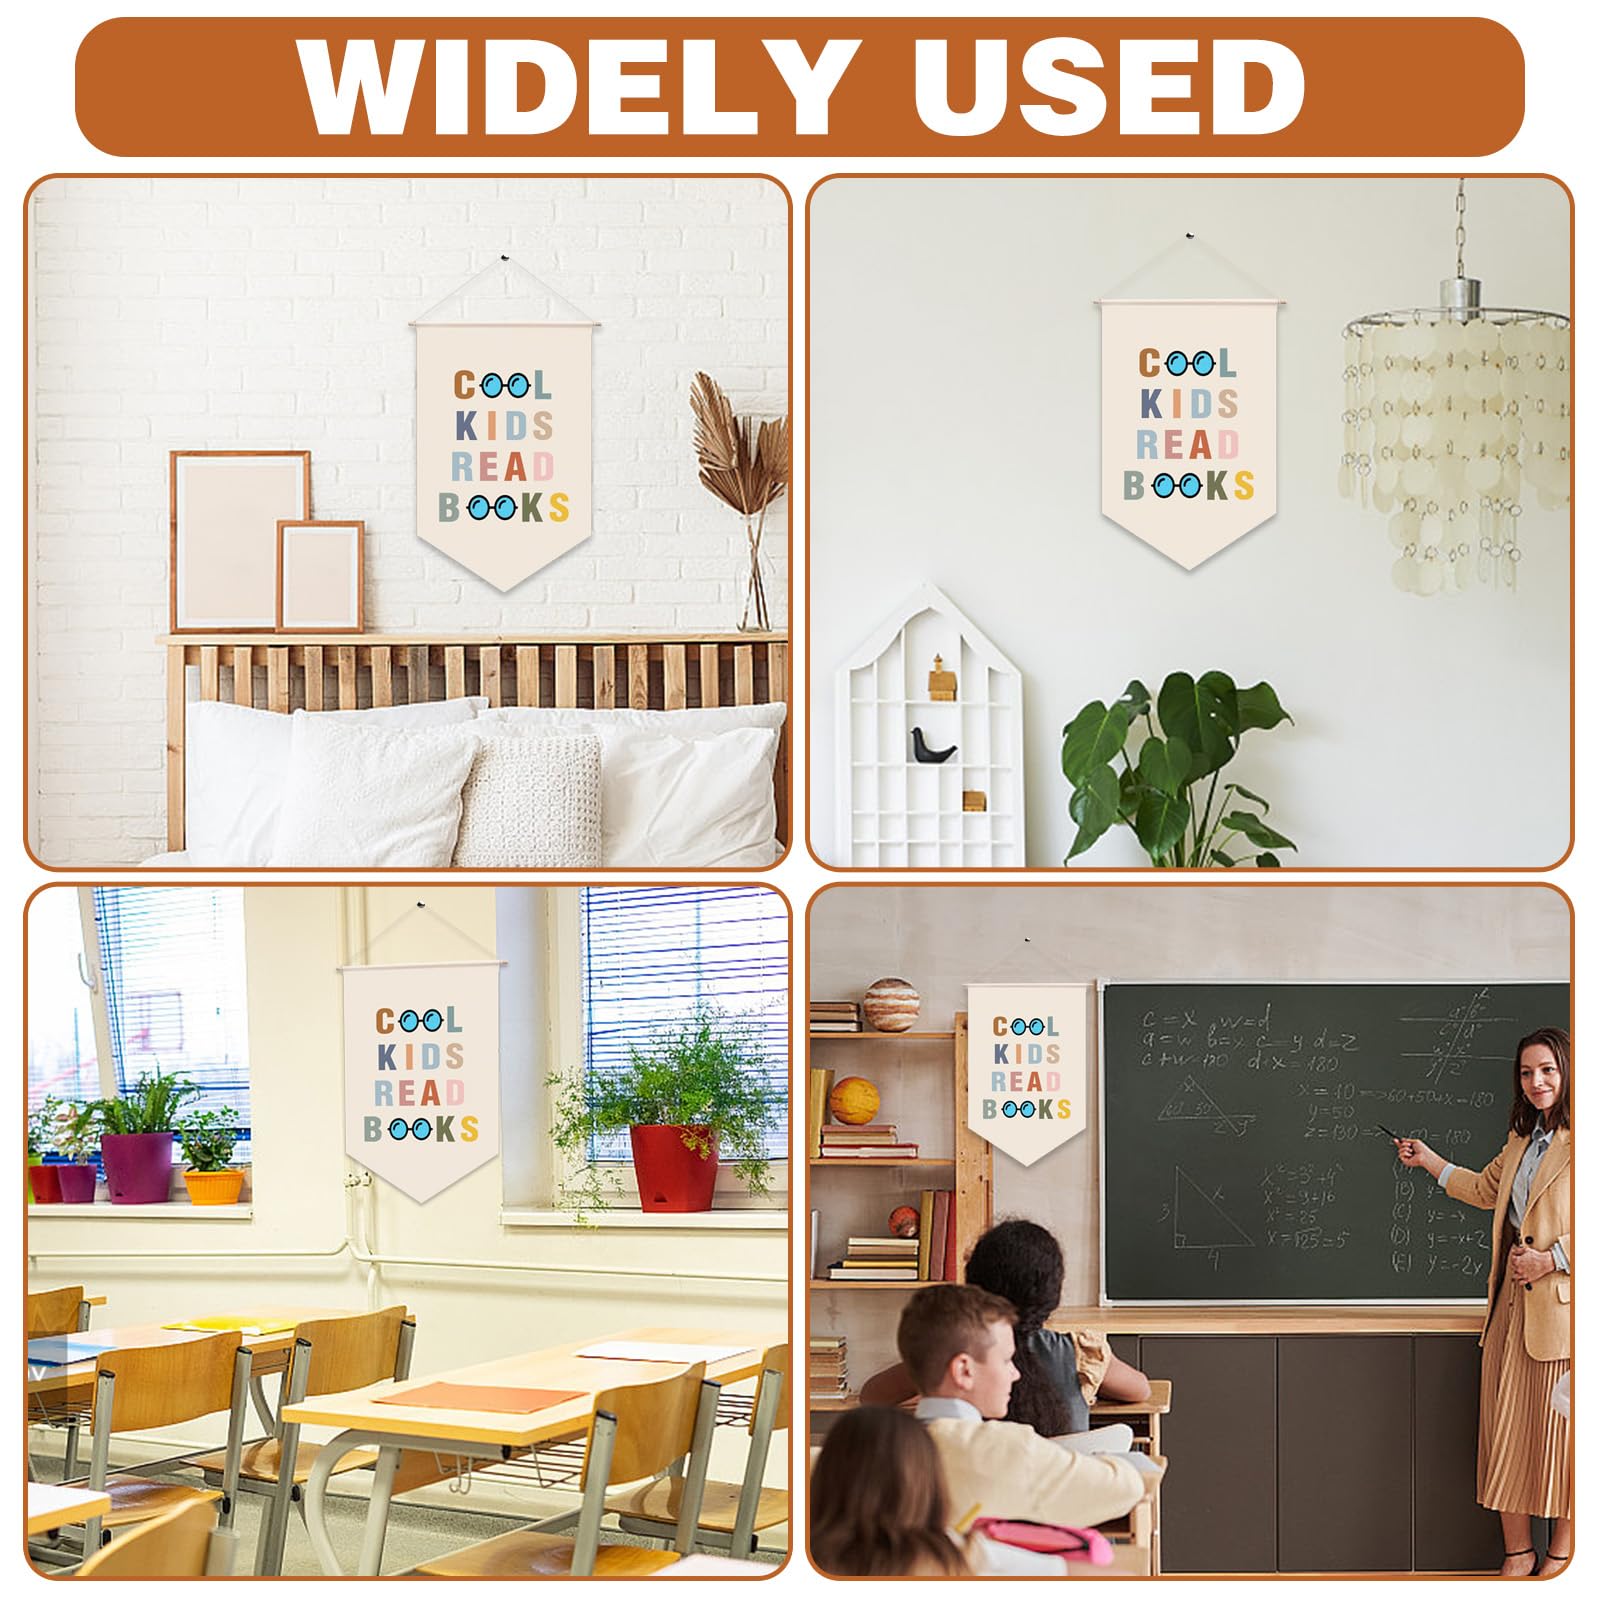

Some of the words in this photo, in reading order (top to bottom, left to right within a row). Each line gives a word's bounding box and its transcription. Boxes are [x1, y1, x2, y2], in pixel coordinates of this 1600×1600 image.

[1139, 348, 1237, 378] COOL
[454, 370, 552, 400] COOL
[1140, 387, 1238, 420] KIDS
[456, 411, 552, 440] KIDS
[1136, 429, 1239, 460] READ
[452, 451, 553, 481] READ
[1124, 470, 1255, 501] BOOKS
[439, 492, 570, 523] BOOKS
[376, 1010, 463, 1034] COOL
[993, 1016, 1059, 1037] COOL
[378, 1043, 463, 1071] KIDS
[993, 1043, 1060, 1065] KIDS
[375, 1079, 464, 1106] READ
[992, 1071, 1061, 1092] READ
[983, 1099, 1071, 1120] BOOKS
[364, 1115, 479, 1142] BOOKS
